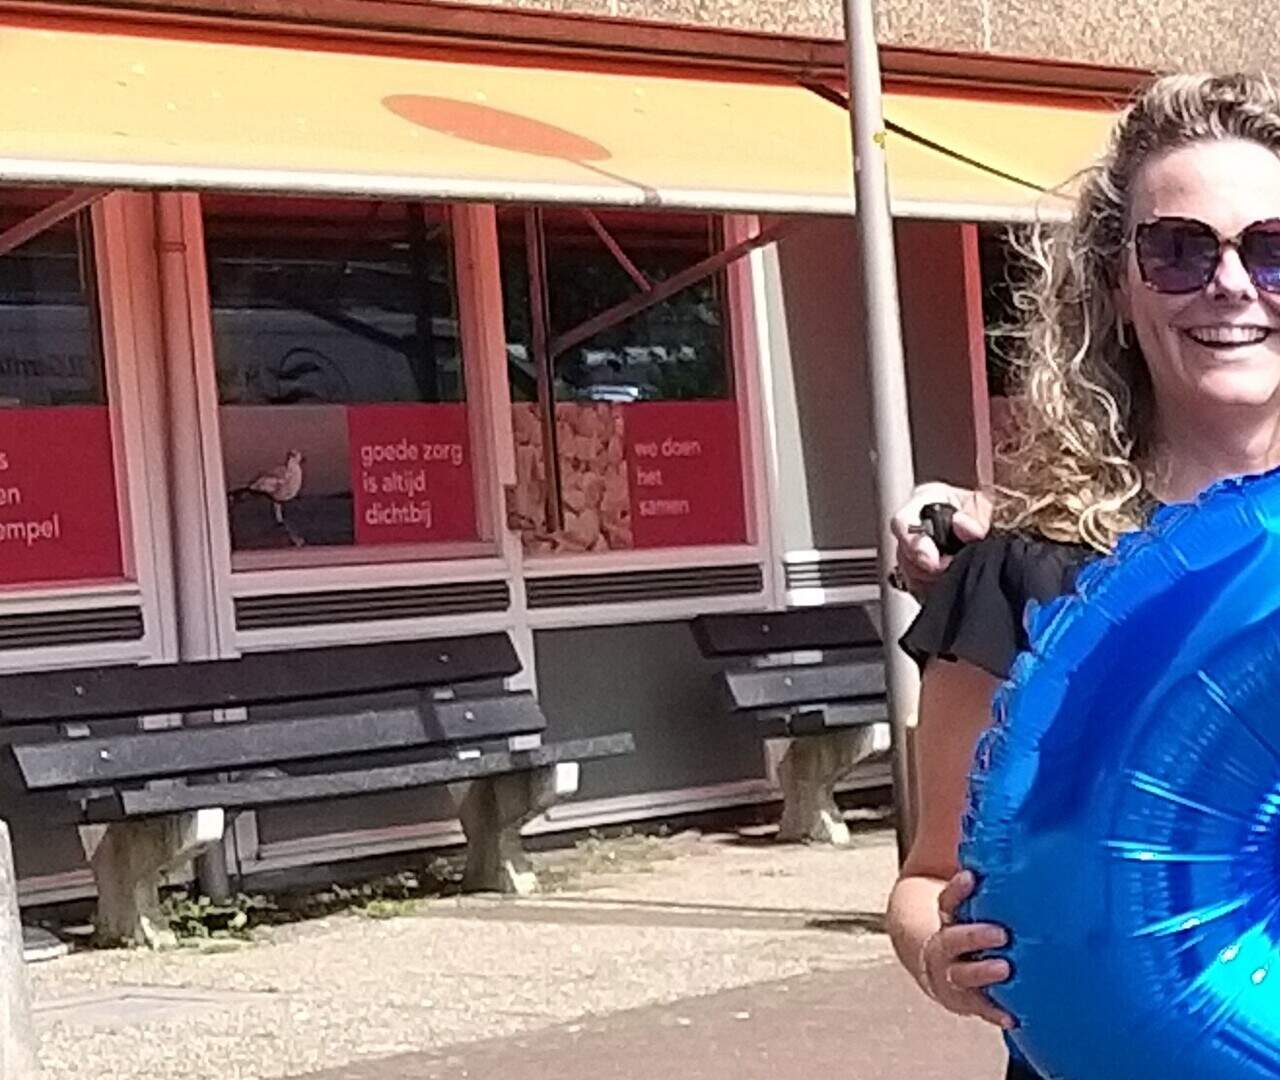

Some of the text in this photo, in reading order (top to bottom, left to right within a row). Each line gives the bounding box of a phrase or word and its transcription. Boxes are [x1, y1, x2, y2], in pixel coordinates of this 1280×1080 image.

[361, 438, 463, 468] goede zorg
[634, 437, 701, 458] we doen
[363, 470, 426, 498] is altijd
[637, 466, 662, 486] het
[365, 500, 432, 529] dichtbij
[639, 500, 690, 517] samen
